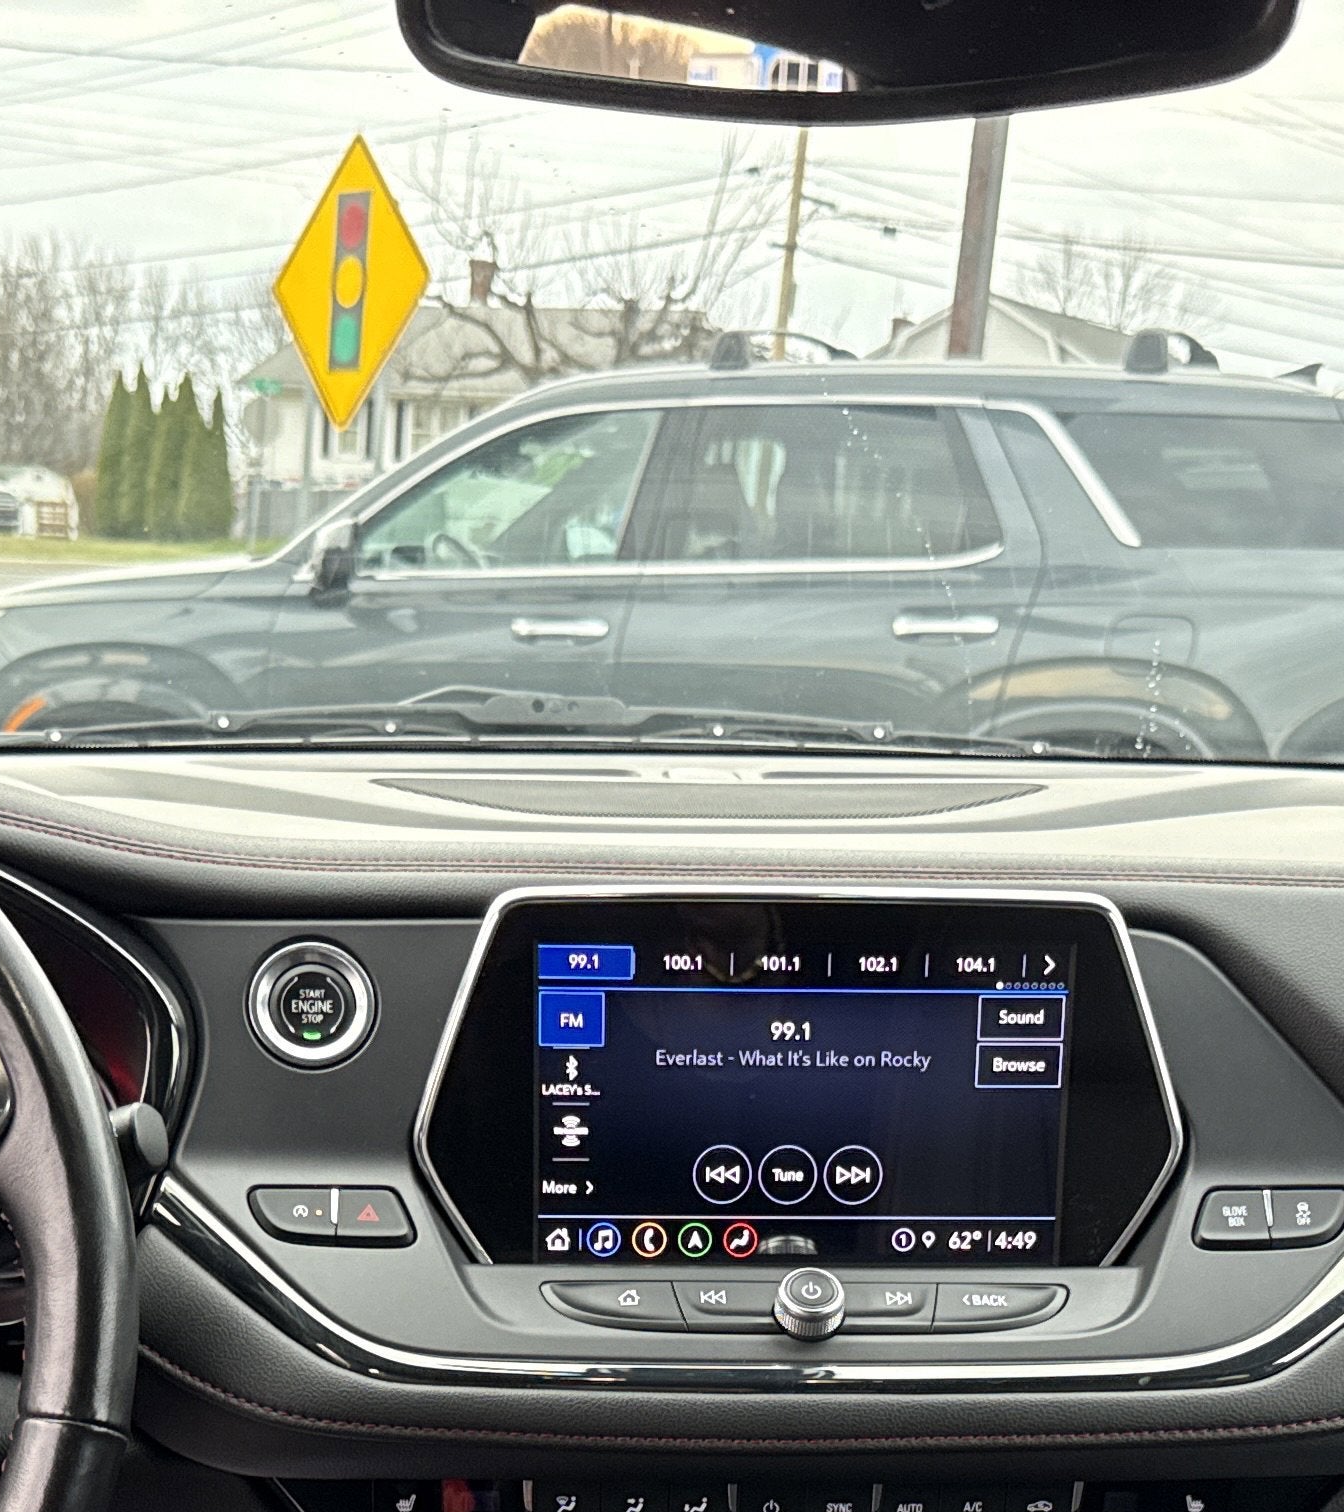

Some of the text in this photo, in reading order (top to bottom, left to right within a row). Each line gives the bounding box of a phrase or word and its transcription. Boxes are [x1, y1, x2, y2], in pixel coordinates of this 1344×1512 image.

[568, 953, 600, 970] 99.1
[662, 954, 703, 971] 100.1
[761, 956, 801, 972] 101.1
[859, 956, 899, 973] 102.1
[956, 957, 996, 973] 104.1
[299, 989, 325, 998] START
[292, 1000, 333, 1013] ENGINE
[301, 1014, 324, 1023] STOP
[560, 1013, 584, 1029] FM
[998, 1008, 1045, 1025] Sound
[770, 1021, 811, 1041] 99.1
[655, 1050, 724, 1067] Everlast
[738, 1050, 783, 1067] What
[787, 1050, 811, 1067] It's
[815, 1051, 849, 1067] Like
[853, 1055, 876, 1067] on
[880, 1051, 932, 1072] Rocky
[992, 1056, 1046, 1073] Browse
[771, 1167, 804, 1183] Tune
[542, 1180, 578, 1194] More
[1222, 1205, 1248, 1217] GLOVE
[1228, 1216, 1245, 1227] BOX
[948, 1230, 982, 1250] 62°
[994, 1230, 1037, 1250] 4:49
[971, 1293, 1008, 1307] BACK
[962, 1501, 984, 1512] A/C
